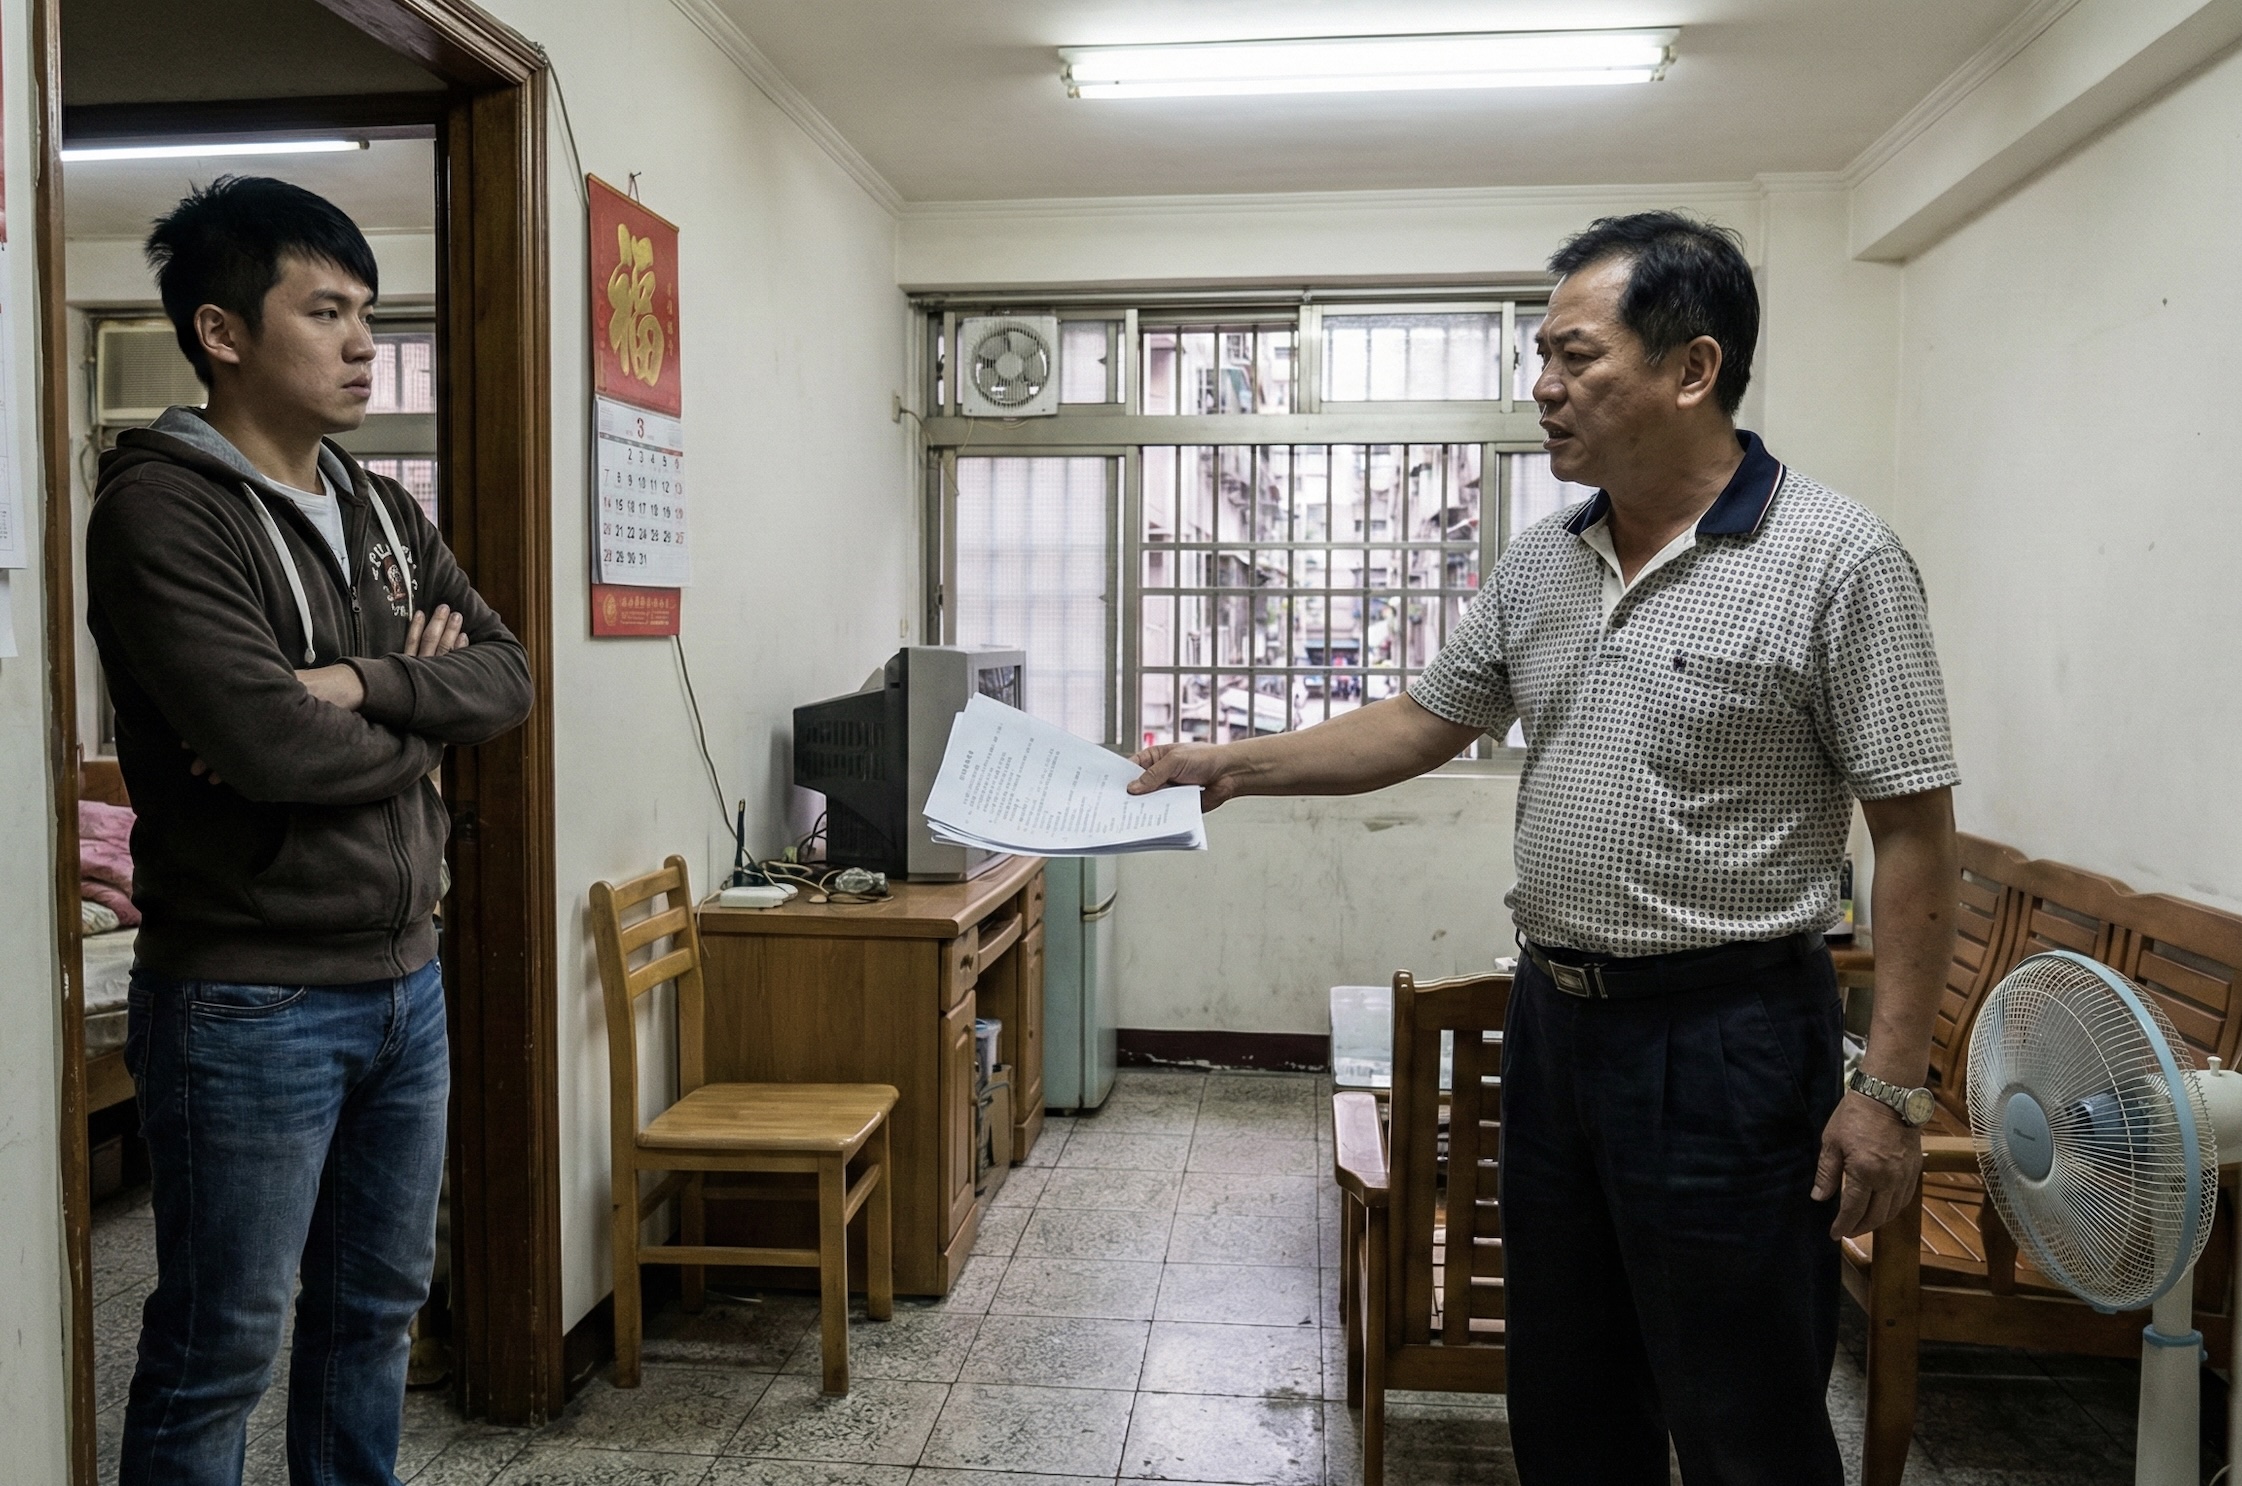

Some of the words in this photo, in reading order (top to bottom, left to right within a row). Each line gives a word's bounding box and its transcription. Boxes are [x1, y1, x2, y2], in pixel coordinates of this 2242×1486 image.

[608, 223, 665, 387] 福
[636, 417, 645, 439] 3
[627, 448, 633, 461] 2
[639, 450, 644, 463] 3
[617, 471, 622, 484] 8
[628, 474, 633, 487] 9
[650, 479, 657, 491] 11
[662, 481, 670, 494] 12
[615, 498, 623, 511] 15
[638, 502, 646, 514] 17
[615, 524, 623, 537] 21
[639, 553, 647, 565] 31
